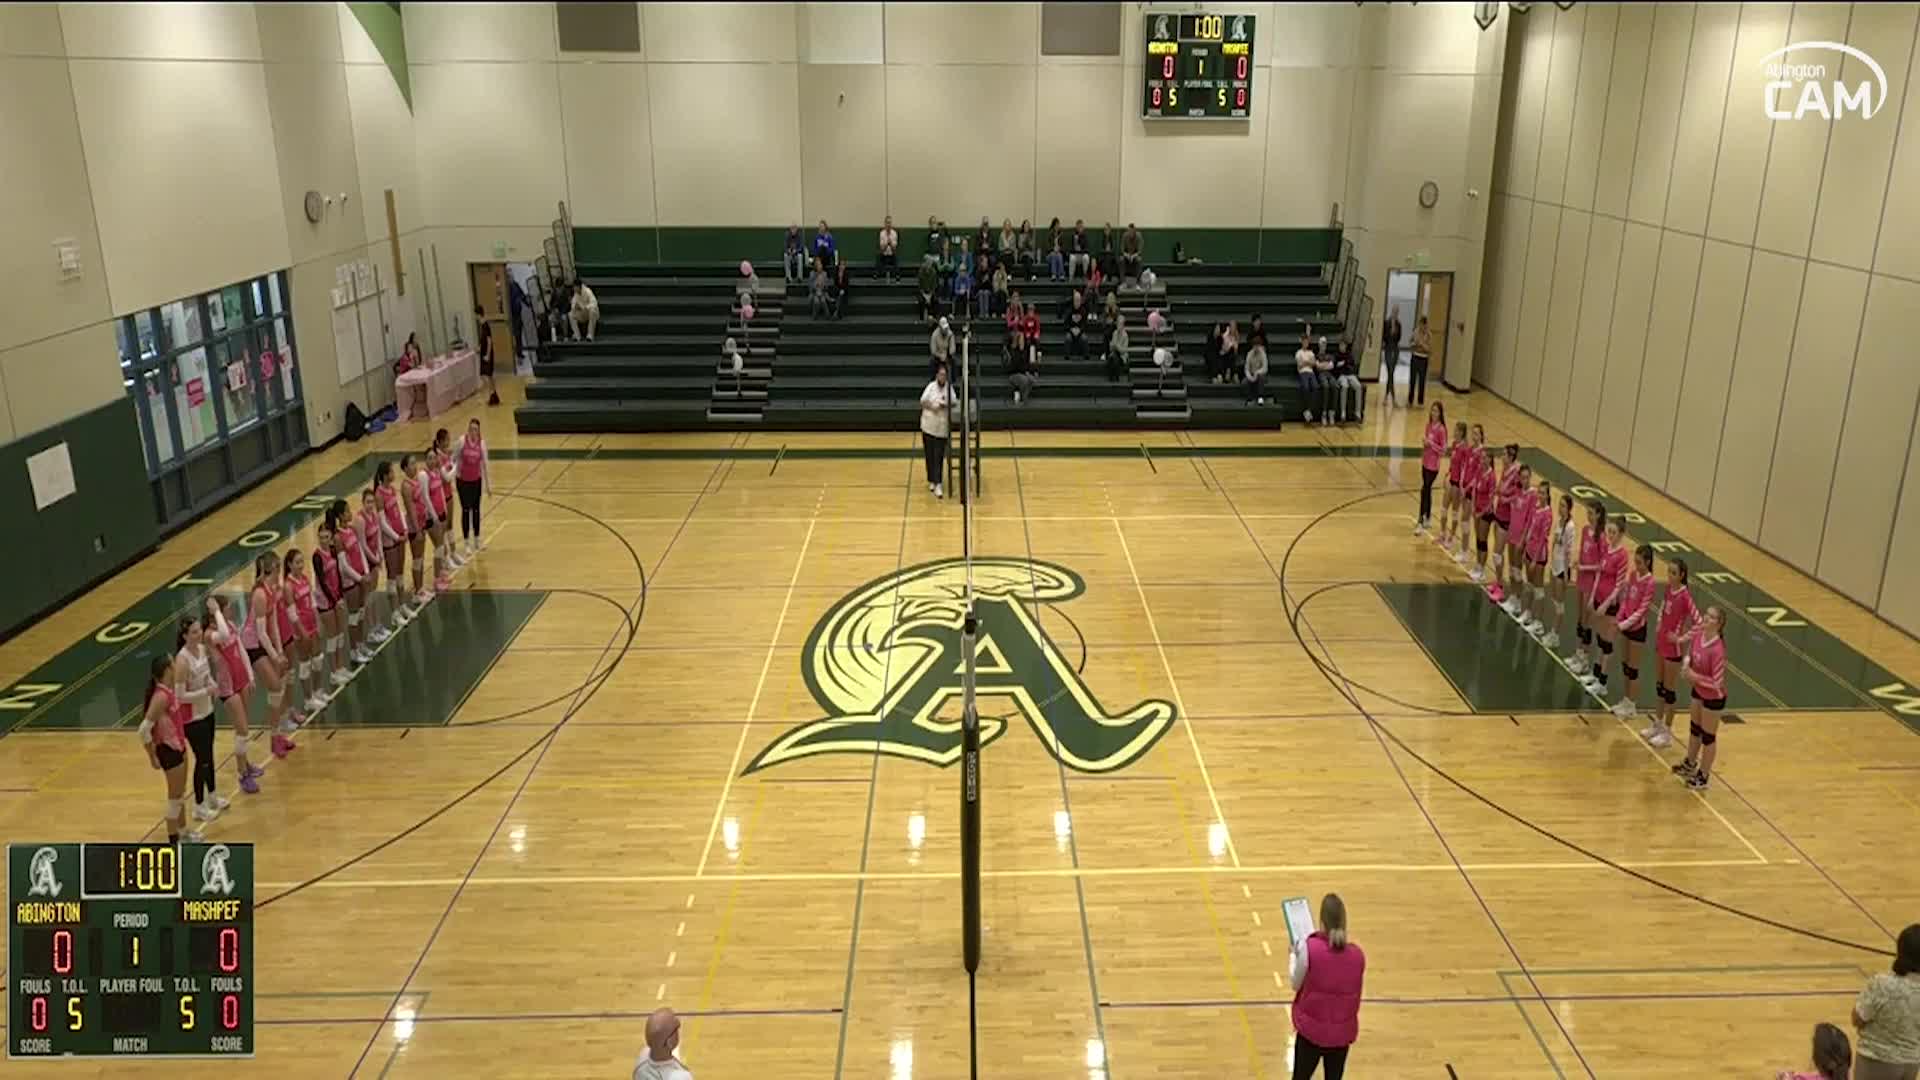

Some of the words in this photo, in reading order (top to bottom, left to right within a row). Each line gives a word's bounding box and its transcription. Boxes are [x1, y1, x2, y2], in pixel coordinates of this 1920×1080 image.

[1195, 16, 1221, 38] 1:00
[1164, 56, 1174, 78] 0
[1237, 56, 1247, 79] 0
